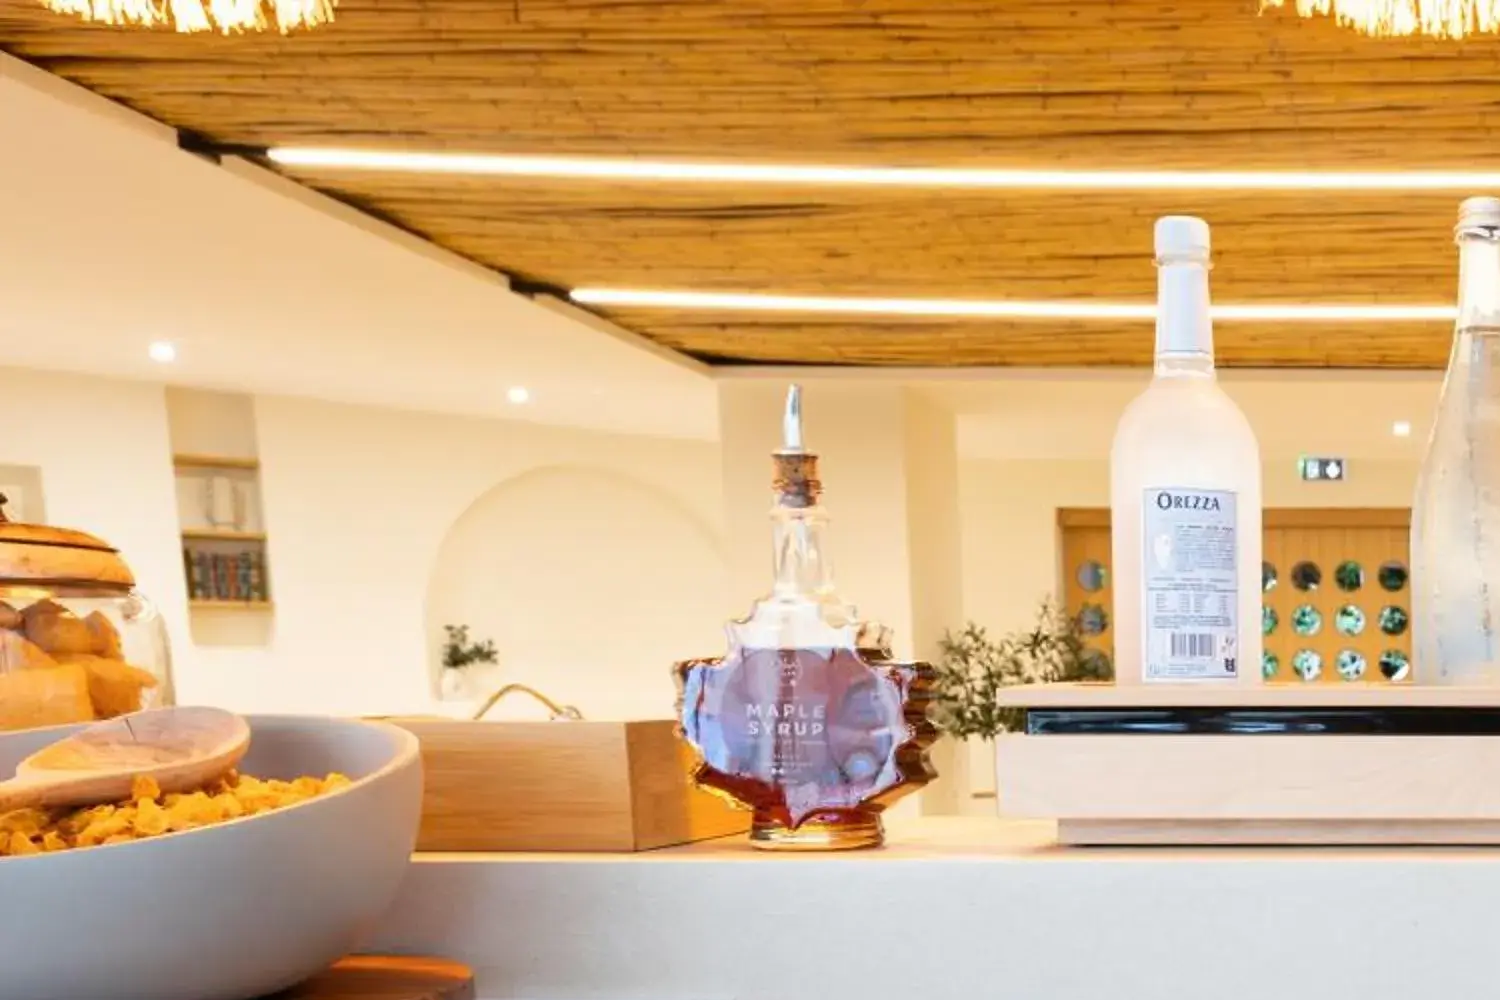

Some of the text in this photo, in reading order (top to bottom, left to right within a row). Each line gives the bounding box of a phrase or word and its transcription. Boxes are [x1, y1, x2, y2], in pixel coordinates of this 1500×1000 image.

[1156, 491, 1220, 511] OREZZA
[746, 703, 825, 719] MAPLE
[749, 721, 825, 736] SYRUP
